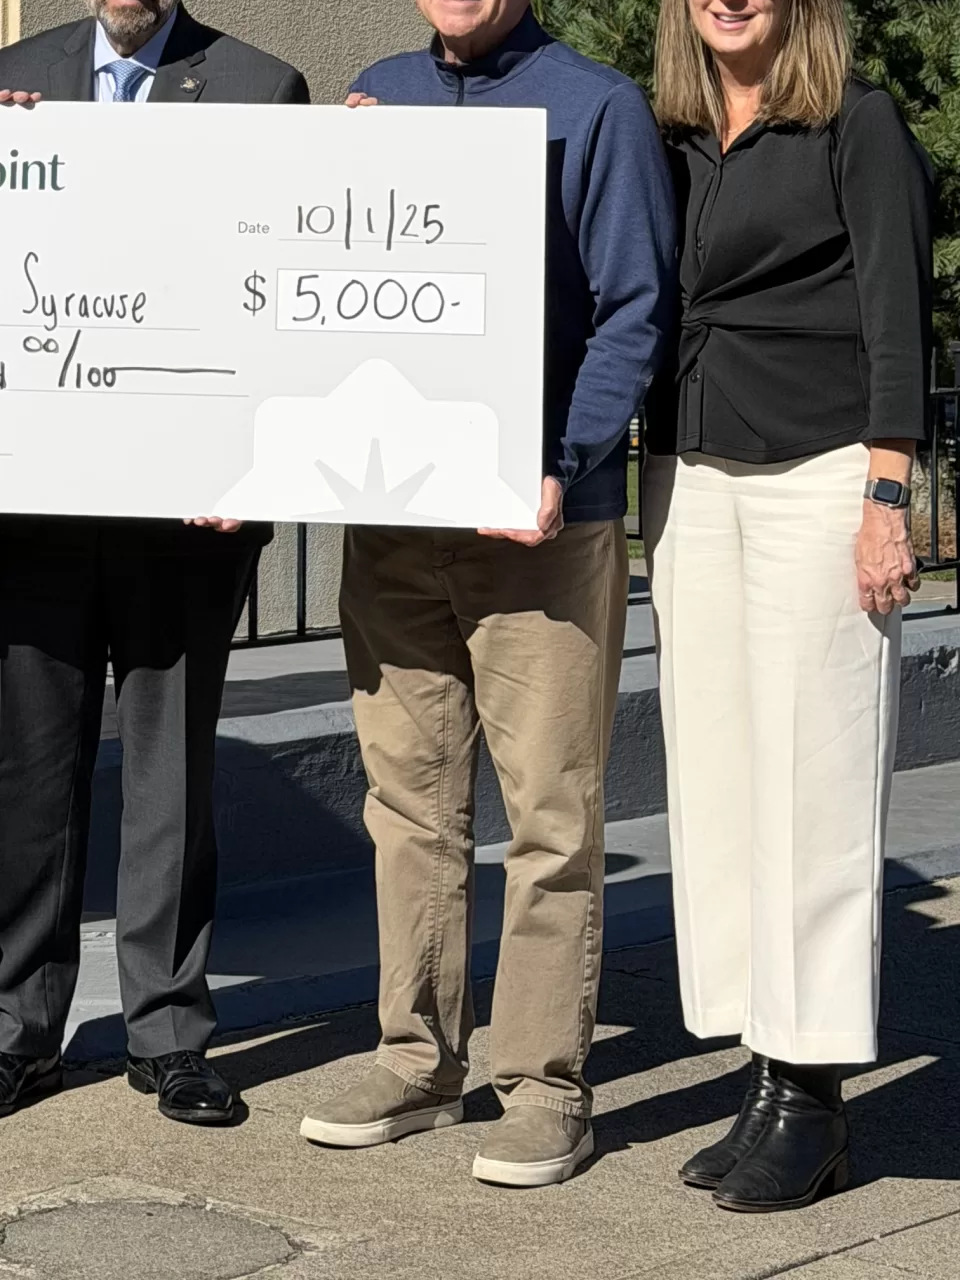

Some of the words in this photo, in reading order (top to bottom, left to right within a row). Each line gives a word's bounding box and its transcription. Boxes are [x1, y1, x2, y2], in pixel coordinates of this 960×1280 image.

[238, 221, 269, 234] Date
[298, 188, 444, 251] 10/1/25
[15, 252, 148, 329] Syracuse
[243, 270, 266, 316] $
